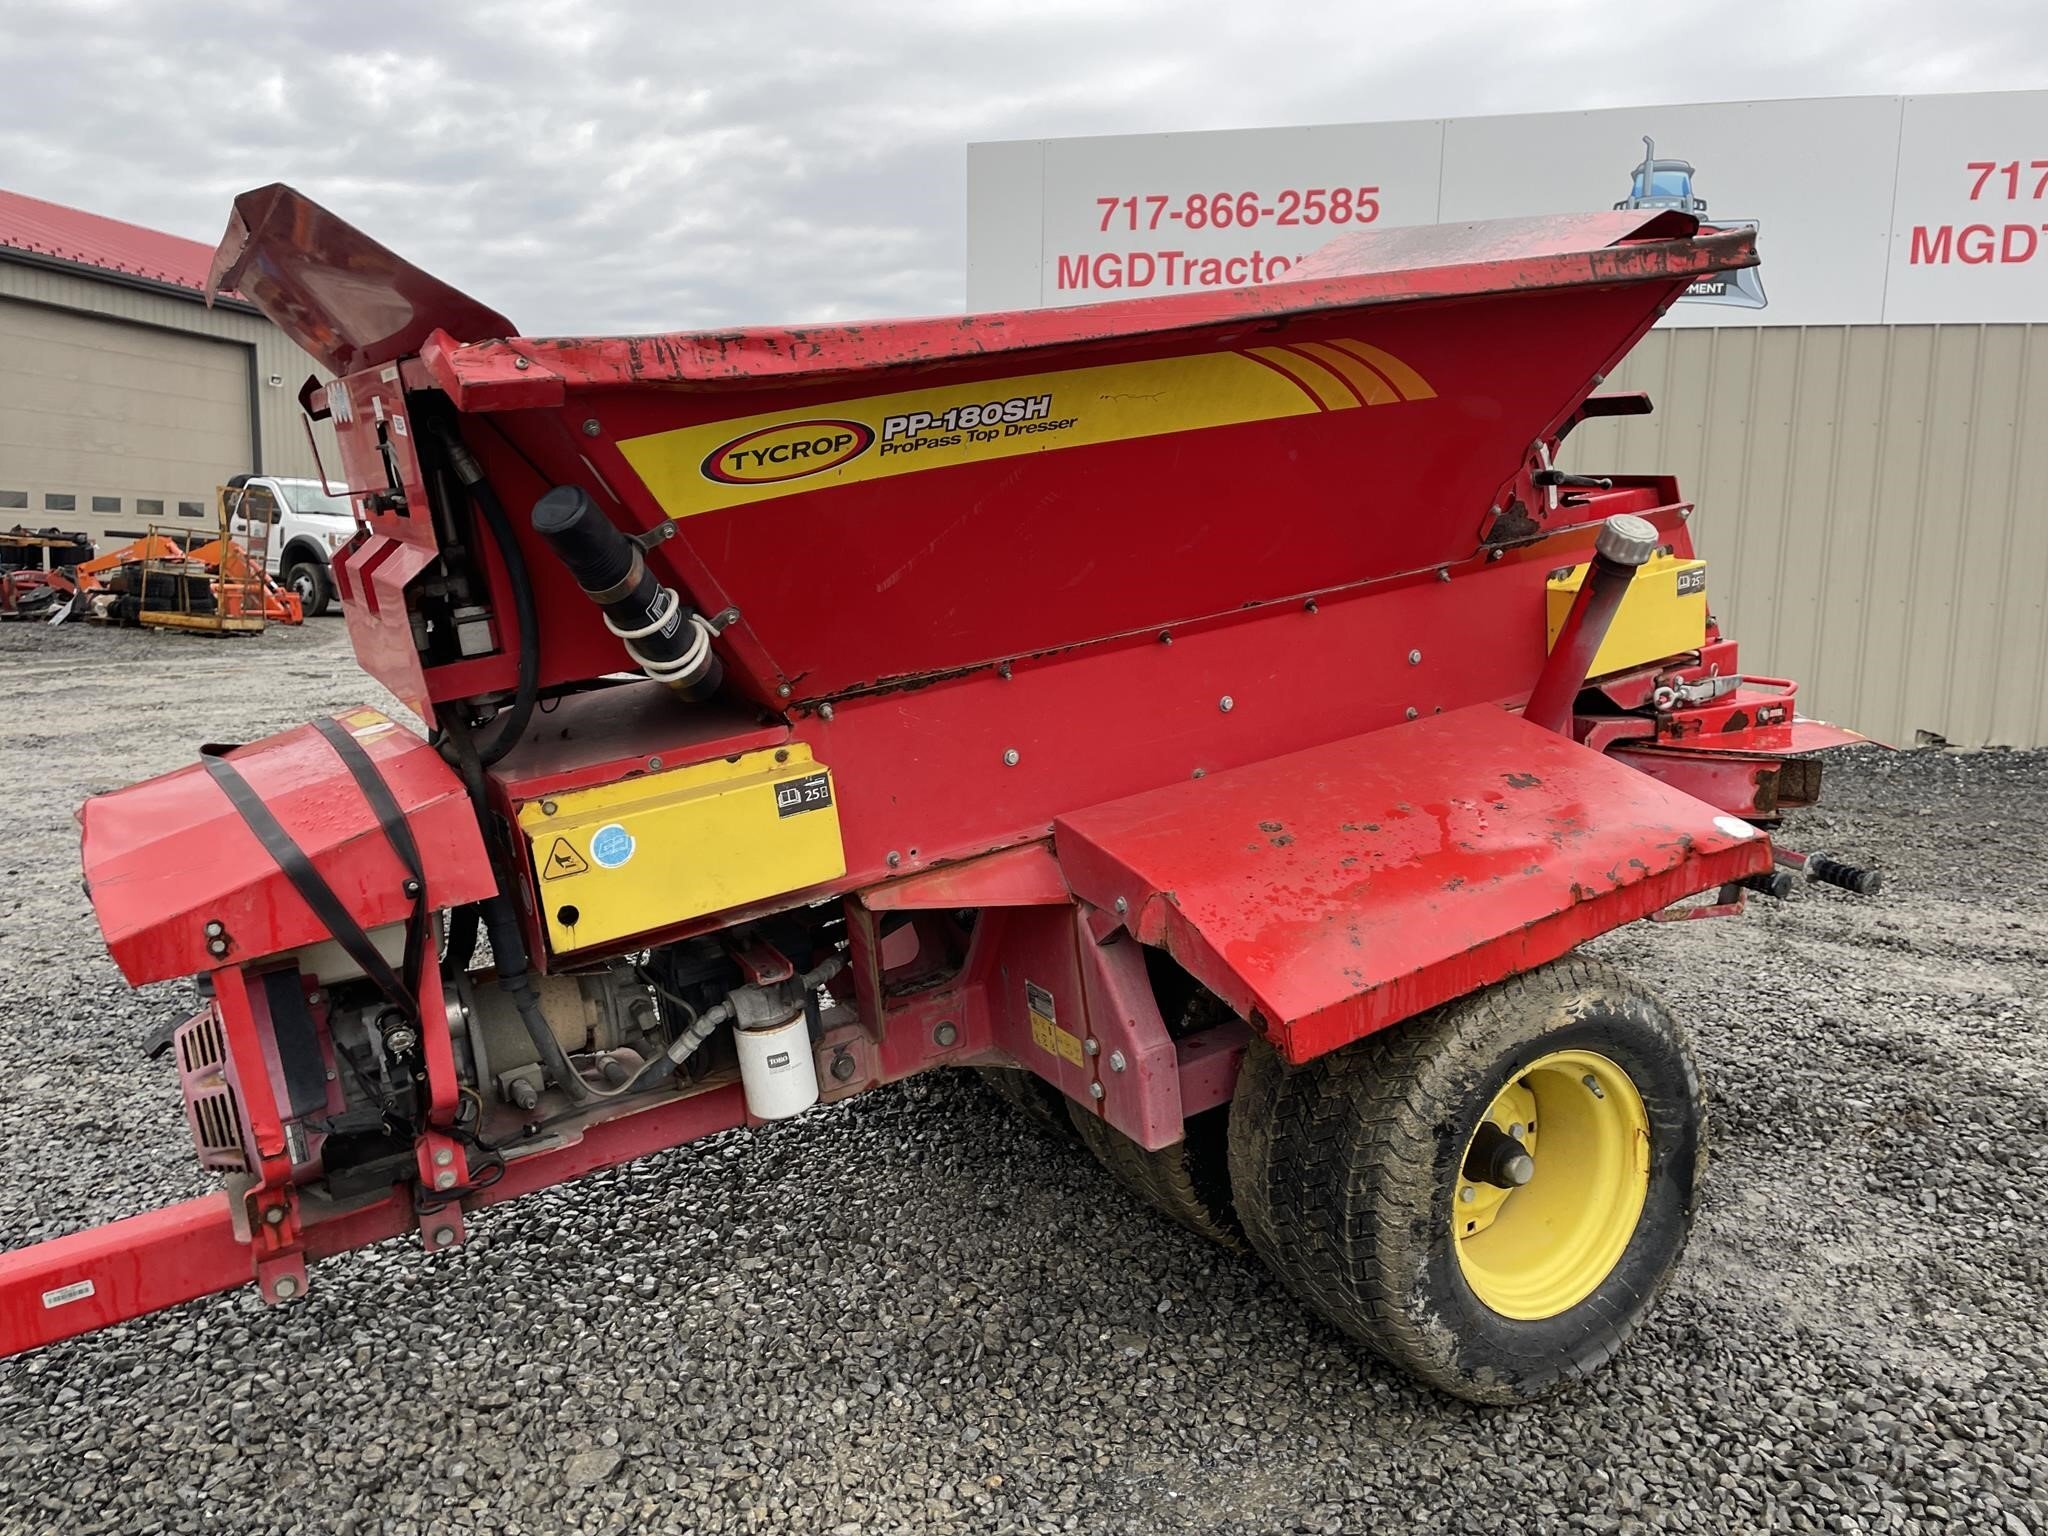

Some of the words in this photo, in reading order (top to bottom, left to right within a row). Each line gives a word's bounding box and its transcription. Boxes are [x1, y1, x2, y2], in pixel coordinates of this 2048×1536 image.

[1096, 186, 1381, 232] 717-866-2585
[1909, 222, 2048, 265] MGD
[1057, 250, 1303, 290] MGDTracto
[1686, 282, 1725, 295] MENT
[880, 434, 962, 457] ProPass
[966, 427, 998, 444] Top
[1004, 416, 1078, 438] Dresser
[882, 394, 1053, 441] PP-180SH
[728, 433, 853, 471] TYCROP
